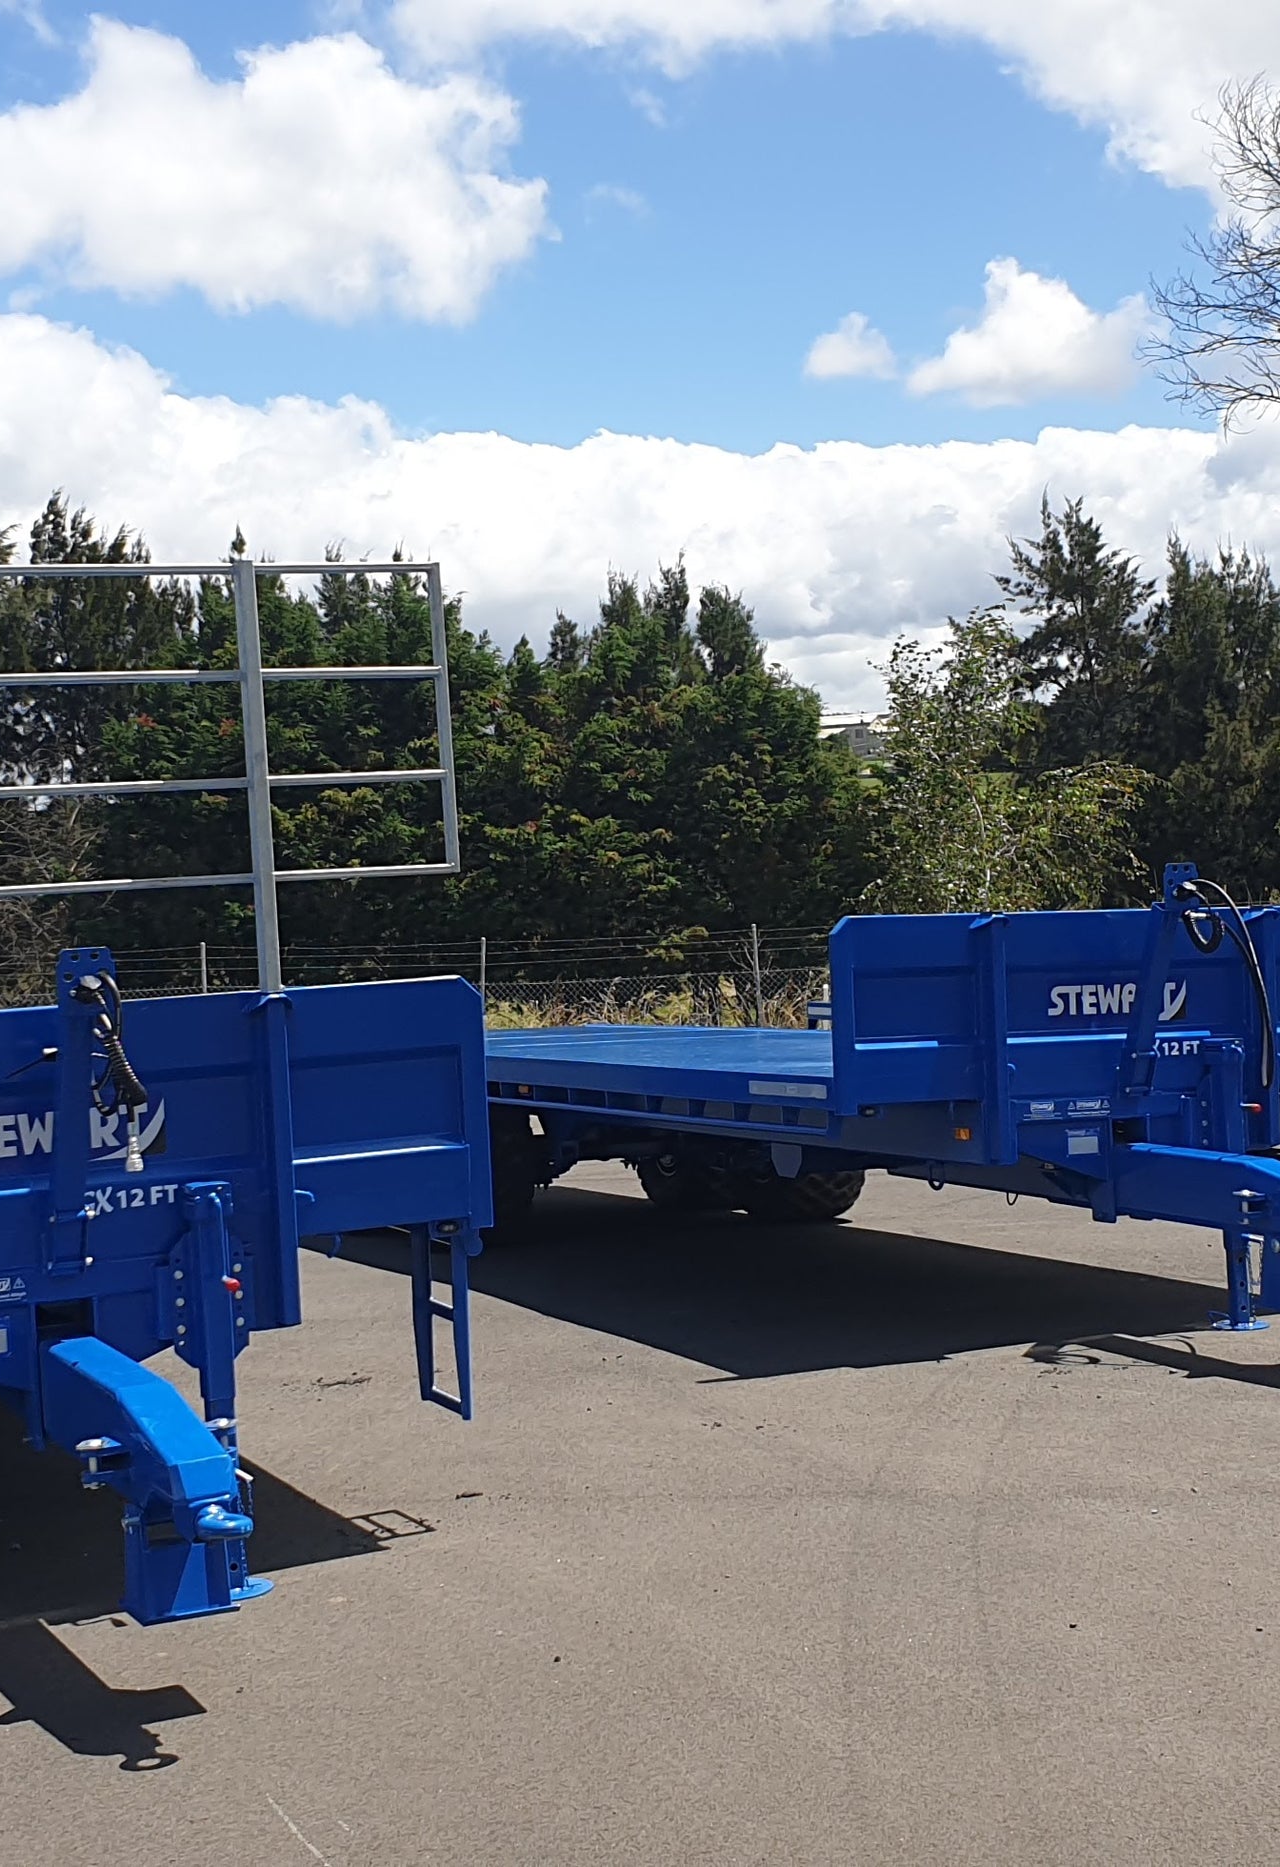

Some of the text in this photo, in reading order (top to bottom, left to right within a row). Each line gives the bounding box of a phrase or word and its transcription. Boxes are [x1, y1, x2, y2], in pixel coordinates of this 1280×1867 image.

[1048, 982, 1176, 1016] STEWAT
[1162, 1042, 1180, 1056] 12
[1182, 1041, 1200, 1055] FT
[116, 1189, 145, 1209] 12
[150, 1184, 179, 1205] FT
